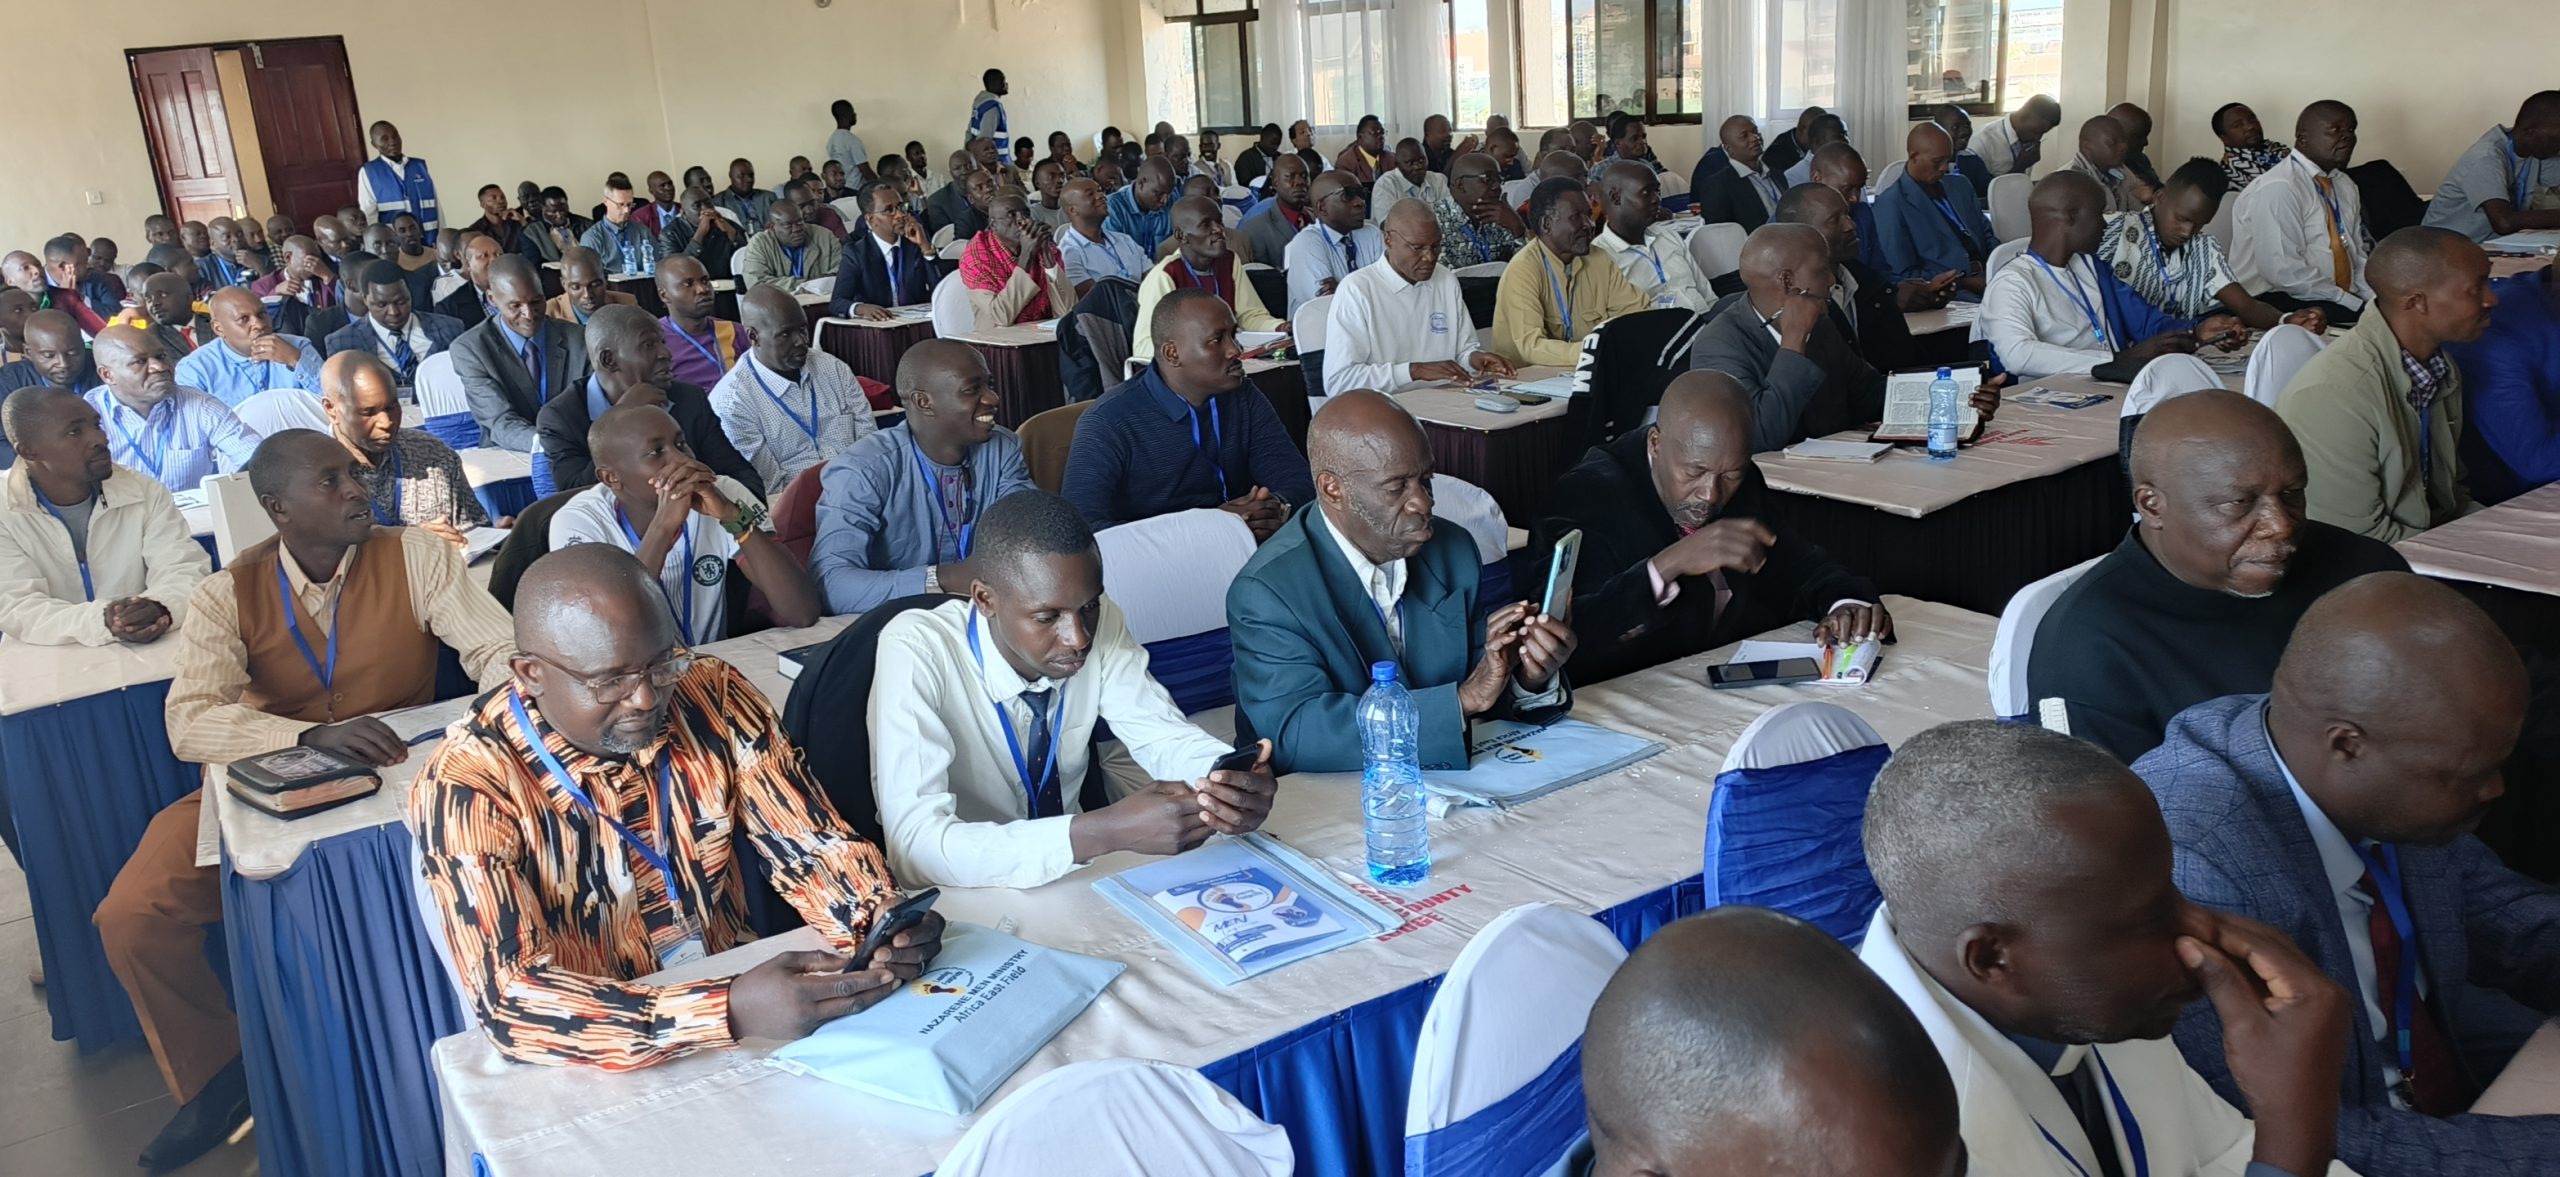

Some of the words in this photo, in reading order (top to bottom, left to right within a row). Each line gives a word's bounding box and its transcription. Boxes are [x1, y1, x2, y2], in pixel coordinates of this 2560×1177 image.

[919, 995, 972, 1034] NAZARENE
[968, 980, 991, 997] MEN
[987, 949, 1028, 981] MINISTRY
[953, 1000, 985, 1023] Africa
[982, 984, 1006, 1001] East
[1000, 966, 1026, 985] Field
